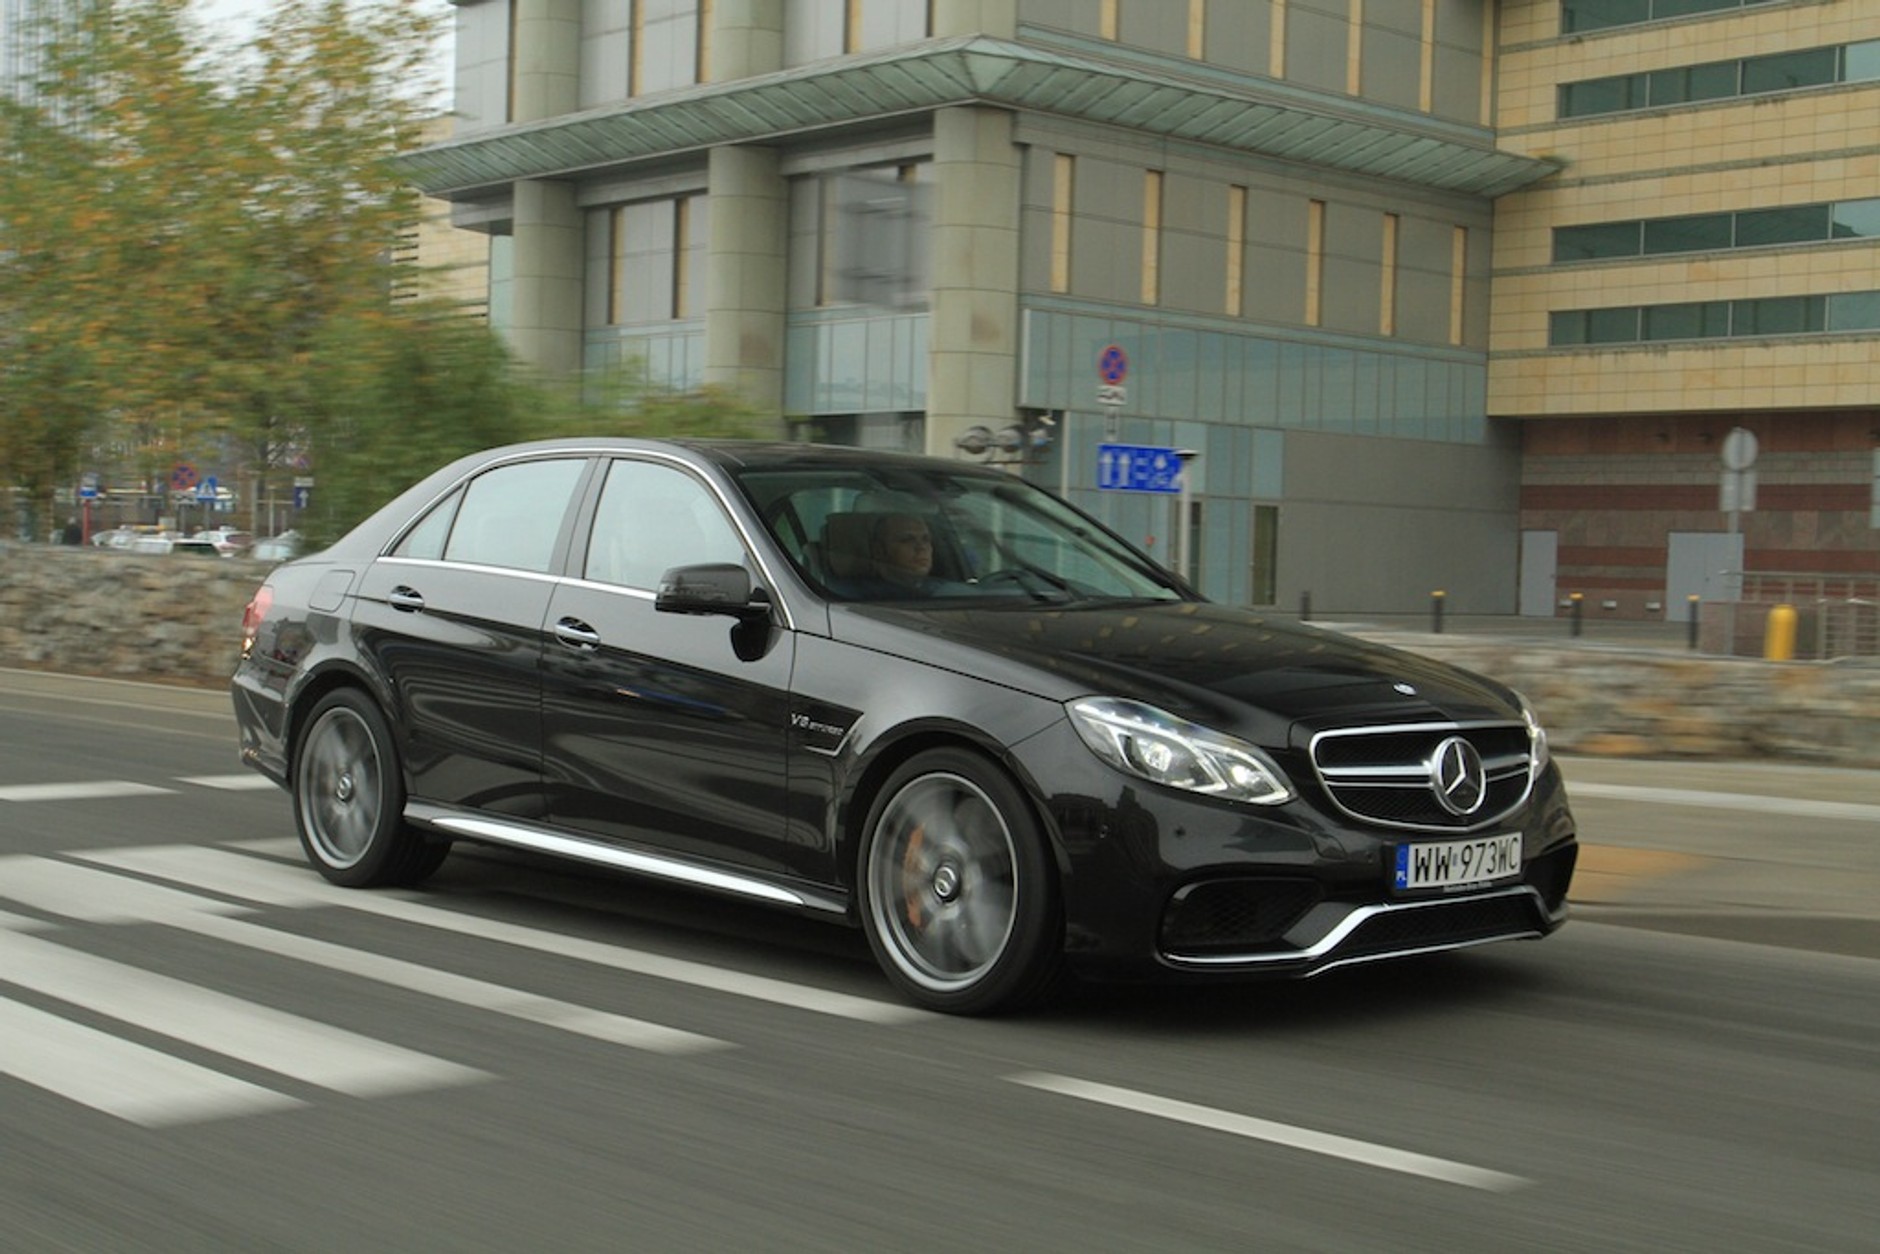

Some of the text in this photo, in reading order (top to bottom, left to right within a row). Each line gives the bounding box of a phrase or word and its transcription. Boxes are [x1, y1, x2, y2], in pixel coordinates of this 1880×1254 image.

[791, 713, 809, 727] V8
[1414, 837, 1519, 882] WW 973WC
[1396, 870, 1407, 881] PL
